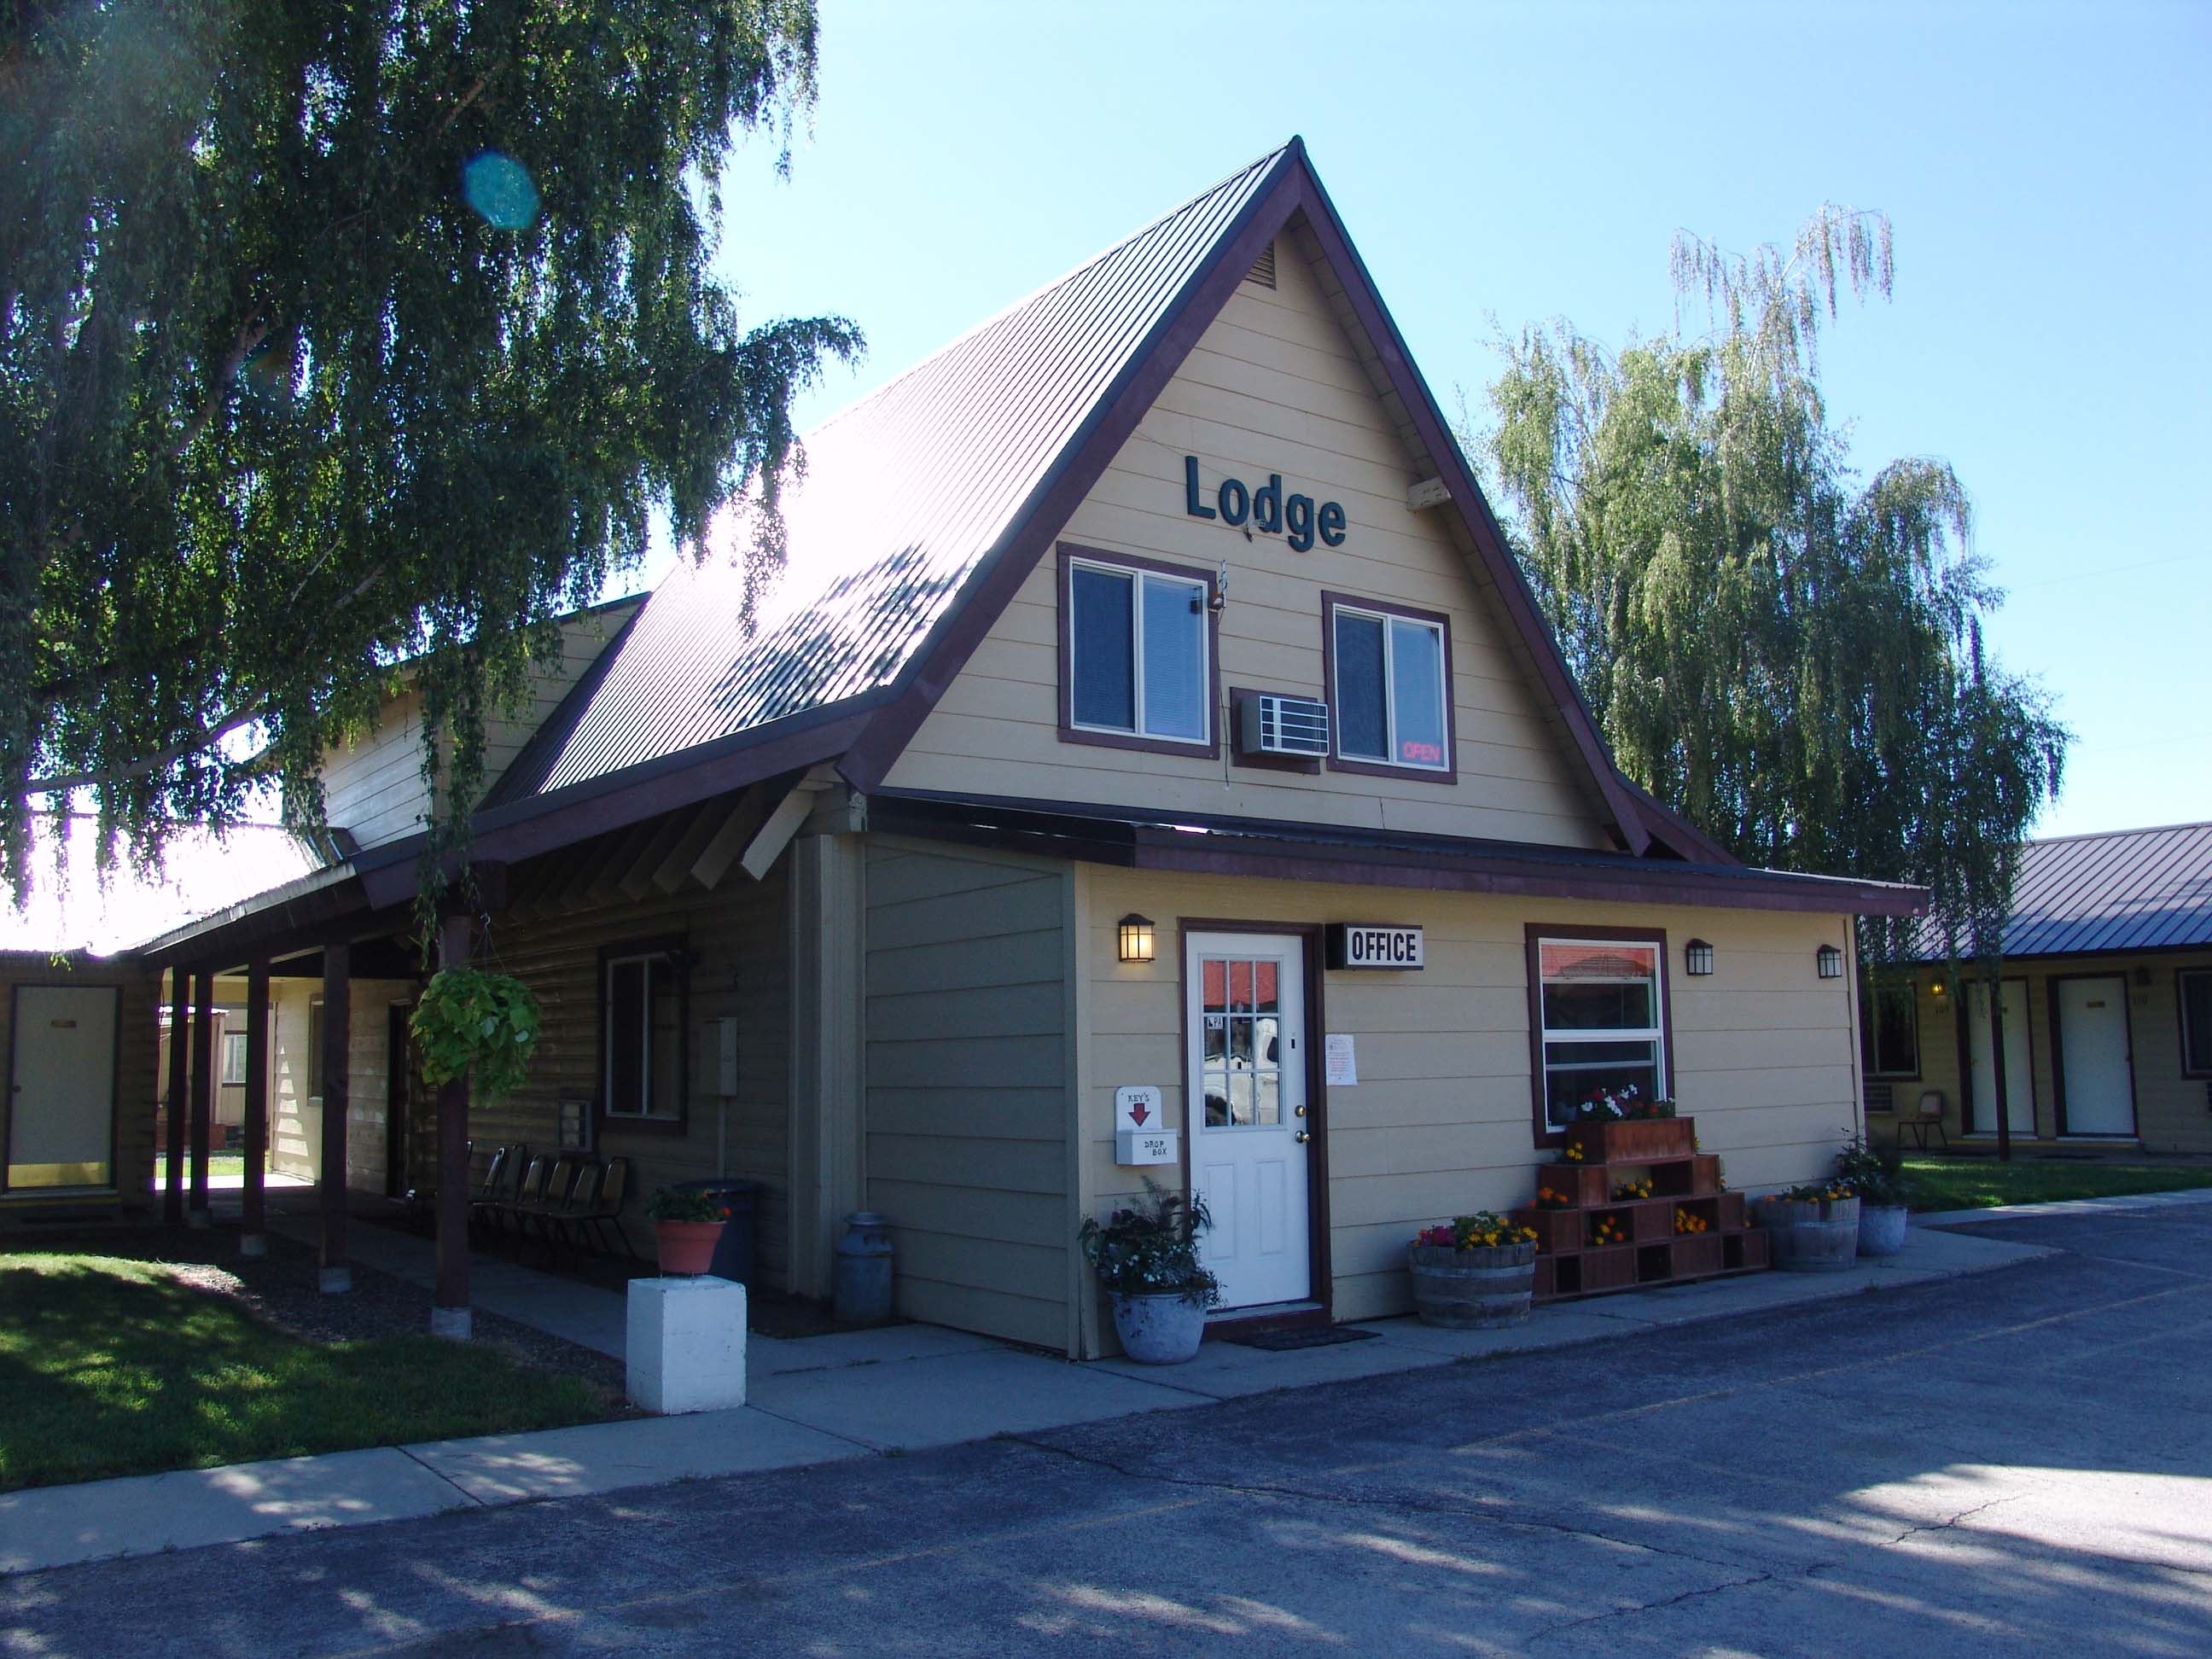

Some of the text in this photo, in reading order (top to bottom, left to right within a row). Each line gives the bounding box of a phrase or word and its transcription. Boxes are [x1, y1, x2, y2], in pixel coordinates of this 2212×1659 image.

[1185, 456, 1347, 553] Lodge
[1403, 742, 1441, 762] OPEN
[1352, 931, 1416, 962] OFFICE
[1127, 1093, 1150, 1103] KEY'S
[1144, 1140, 1165, 1149] DROP
[1152, 1148, 1167, 1156] BOX
